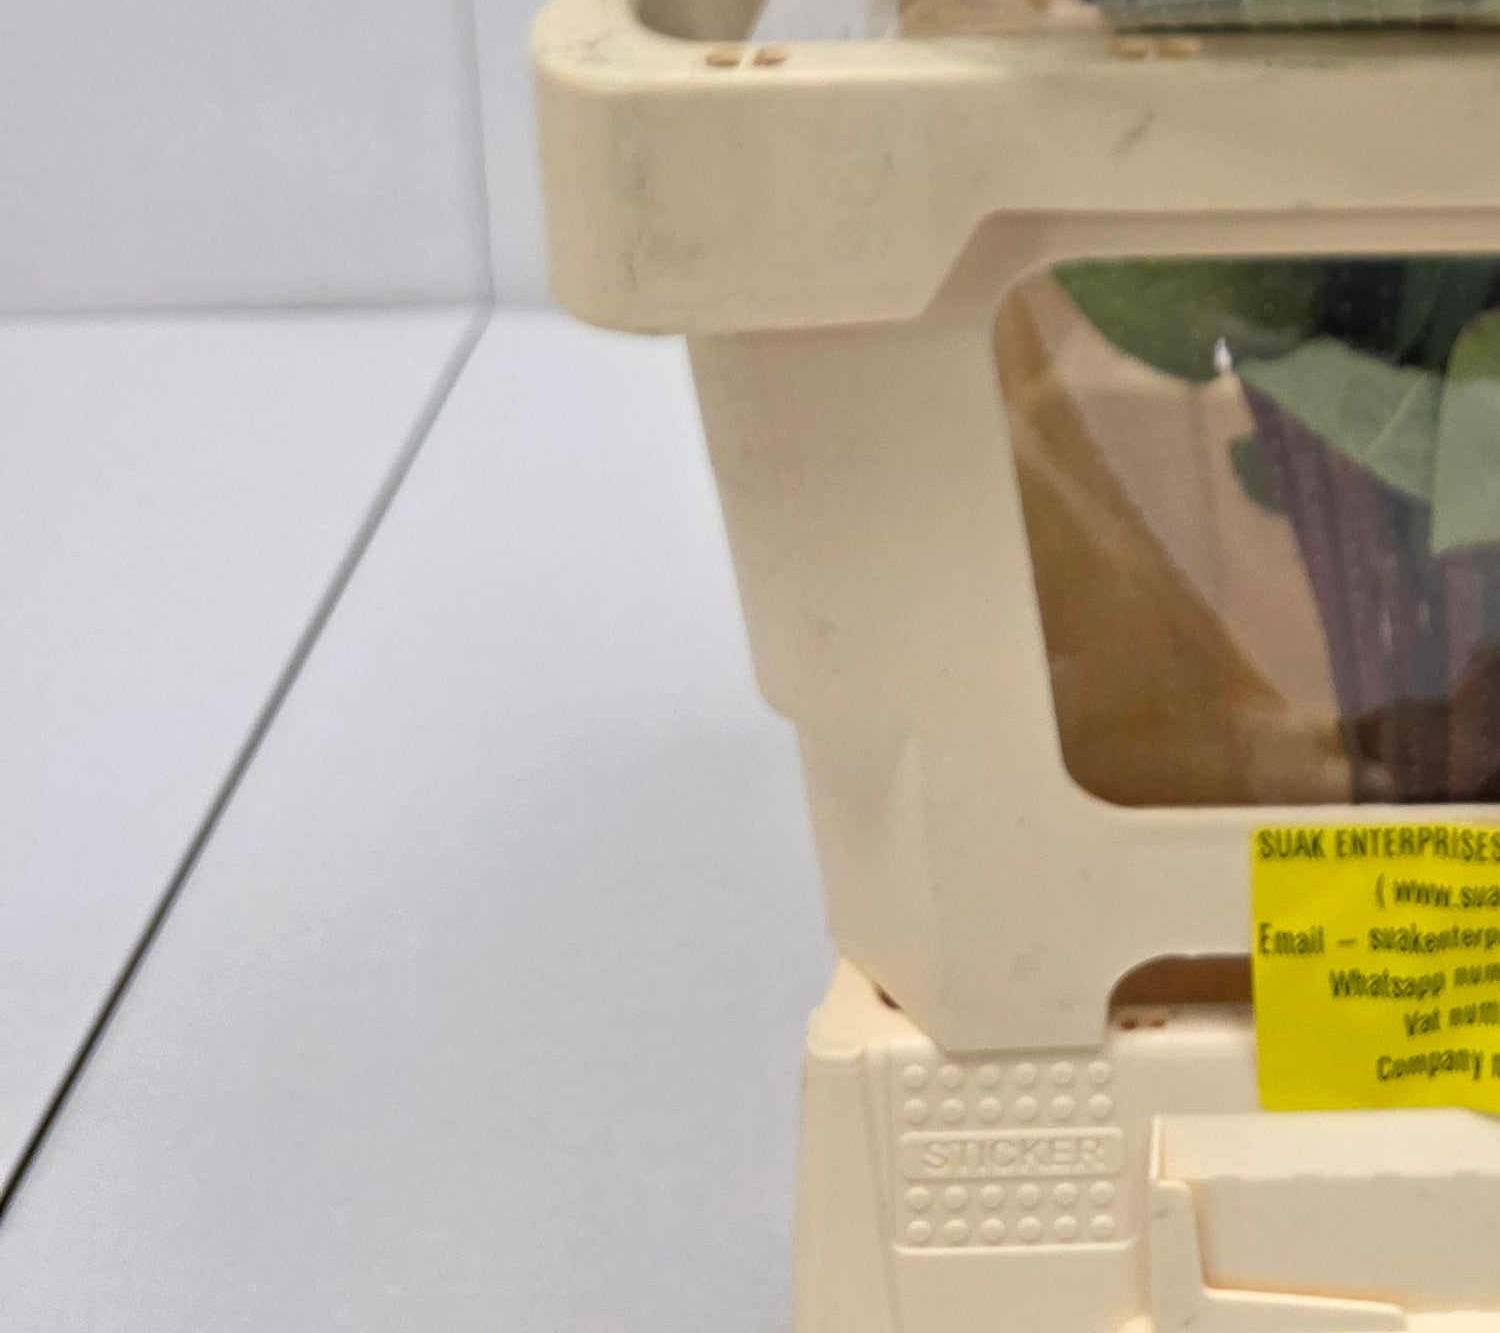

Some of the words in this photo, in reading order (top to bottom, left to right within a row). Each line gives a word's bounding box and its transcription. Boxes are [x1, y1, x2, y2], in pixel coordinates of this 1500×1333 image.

[1257, 829, 1325, 859] SUAK
[1258, 922, 1324, 954] Email
[1329, 967, 1446, 999] Whatsapp
[1404, 1007, 1441, 1036] Vat
[1377, 1049, 1484, 1080] Company
[921, 1136, 1106, 1174] STICKER
